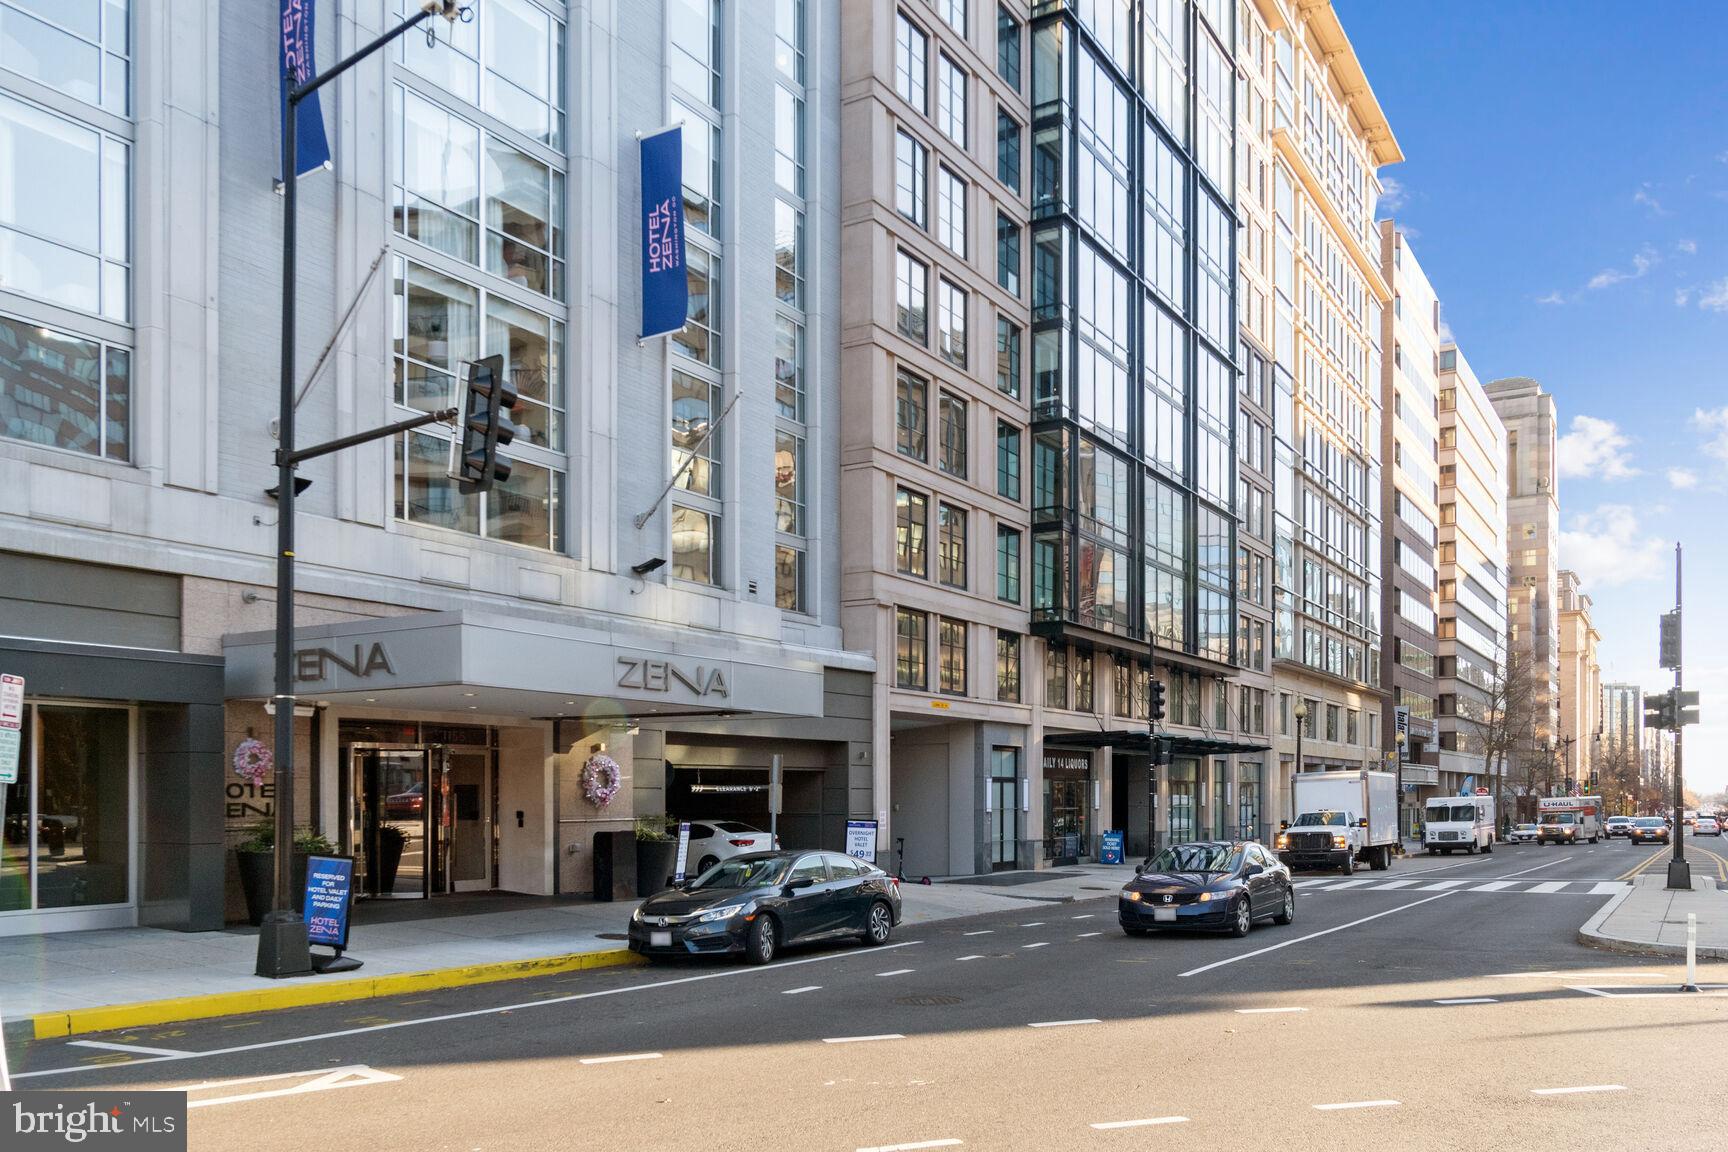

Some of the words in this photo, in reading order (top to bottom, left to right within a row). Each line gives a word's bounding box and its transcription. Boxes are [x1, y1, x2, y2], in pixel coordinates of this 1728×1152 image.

[283, 0, 297, 74] OTEL
[649, 203, 661, 273] HOTEL
[661, 198, 673, 270] ZENA
[274, 641, 397, 682] ENA
[617, 655, 729, 698] ZENA
[1043, 757, 1056, 768] AILY
[1057, 758, 1065, 769] 14
[1065, 758, 1088, 770] LIQUORS
[226, 783, 275, 798] OTE
[226, 803, 275, 817] EN
[313, 872, 345, 881] RESERVED
[308, 886, 327, 894] HOTEL
[328, 888, 348, 896] VALET
[312, 901, 340, 909] PARKING
[310, 917, 339, 926] HOTEL
[310, 925, 339, 935] ZENA
